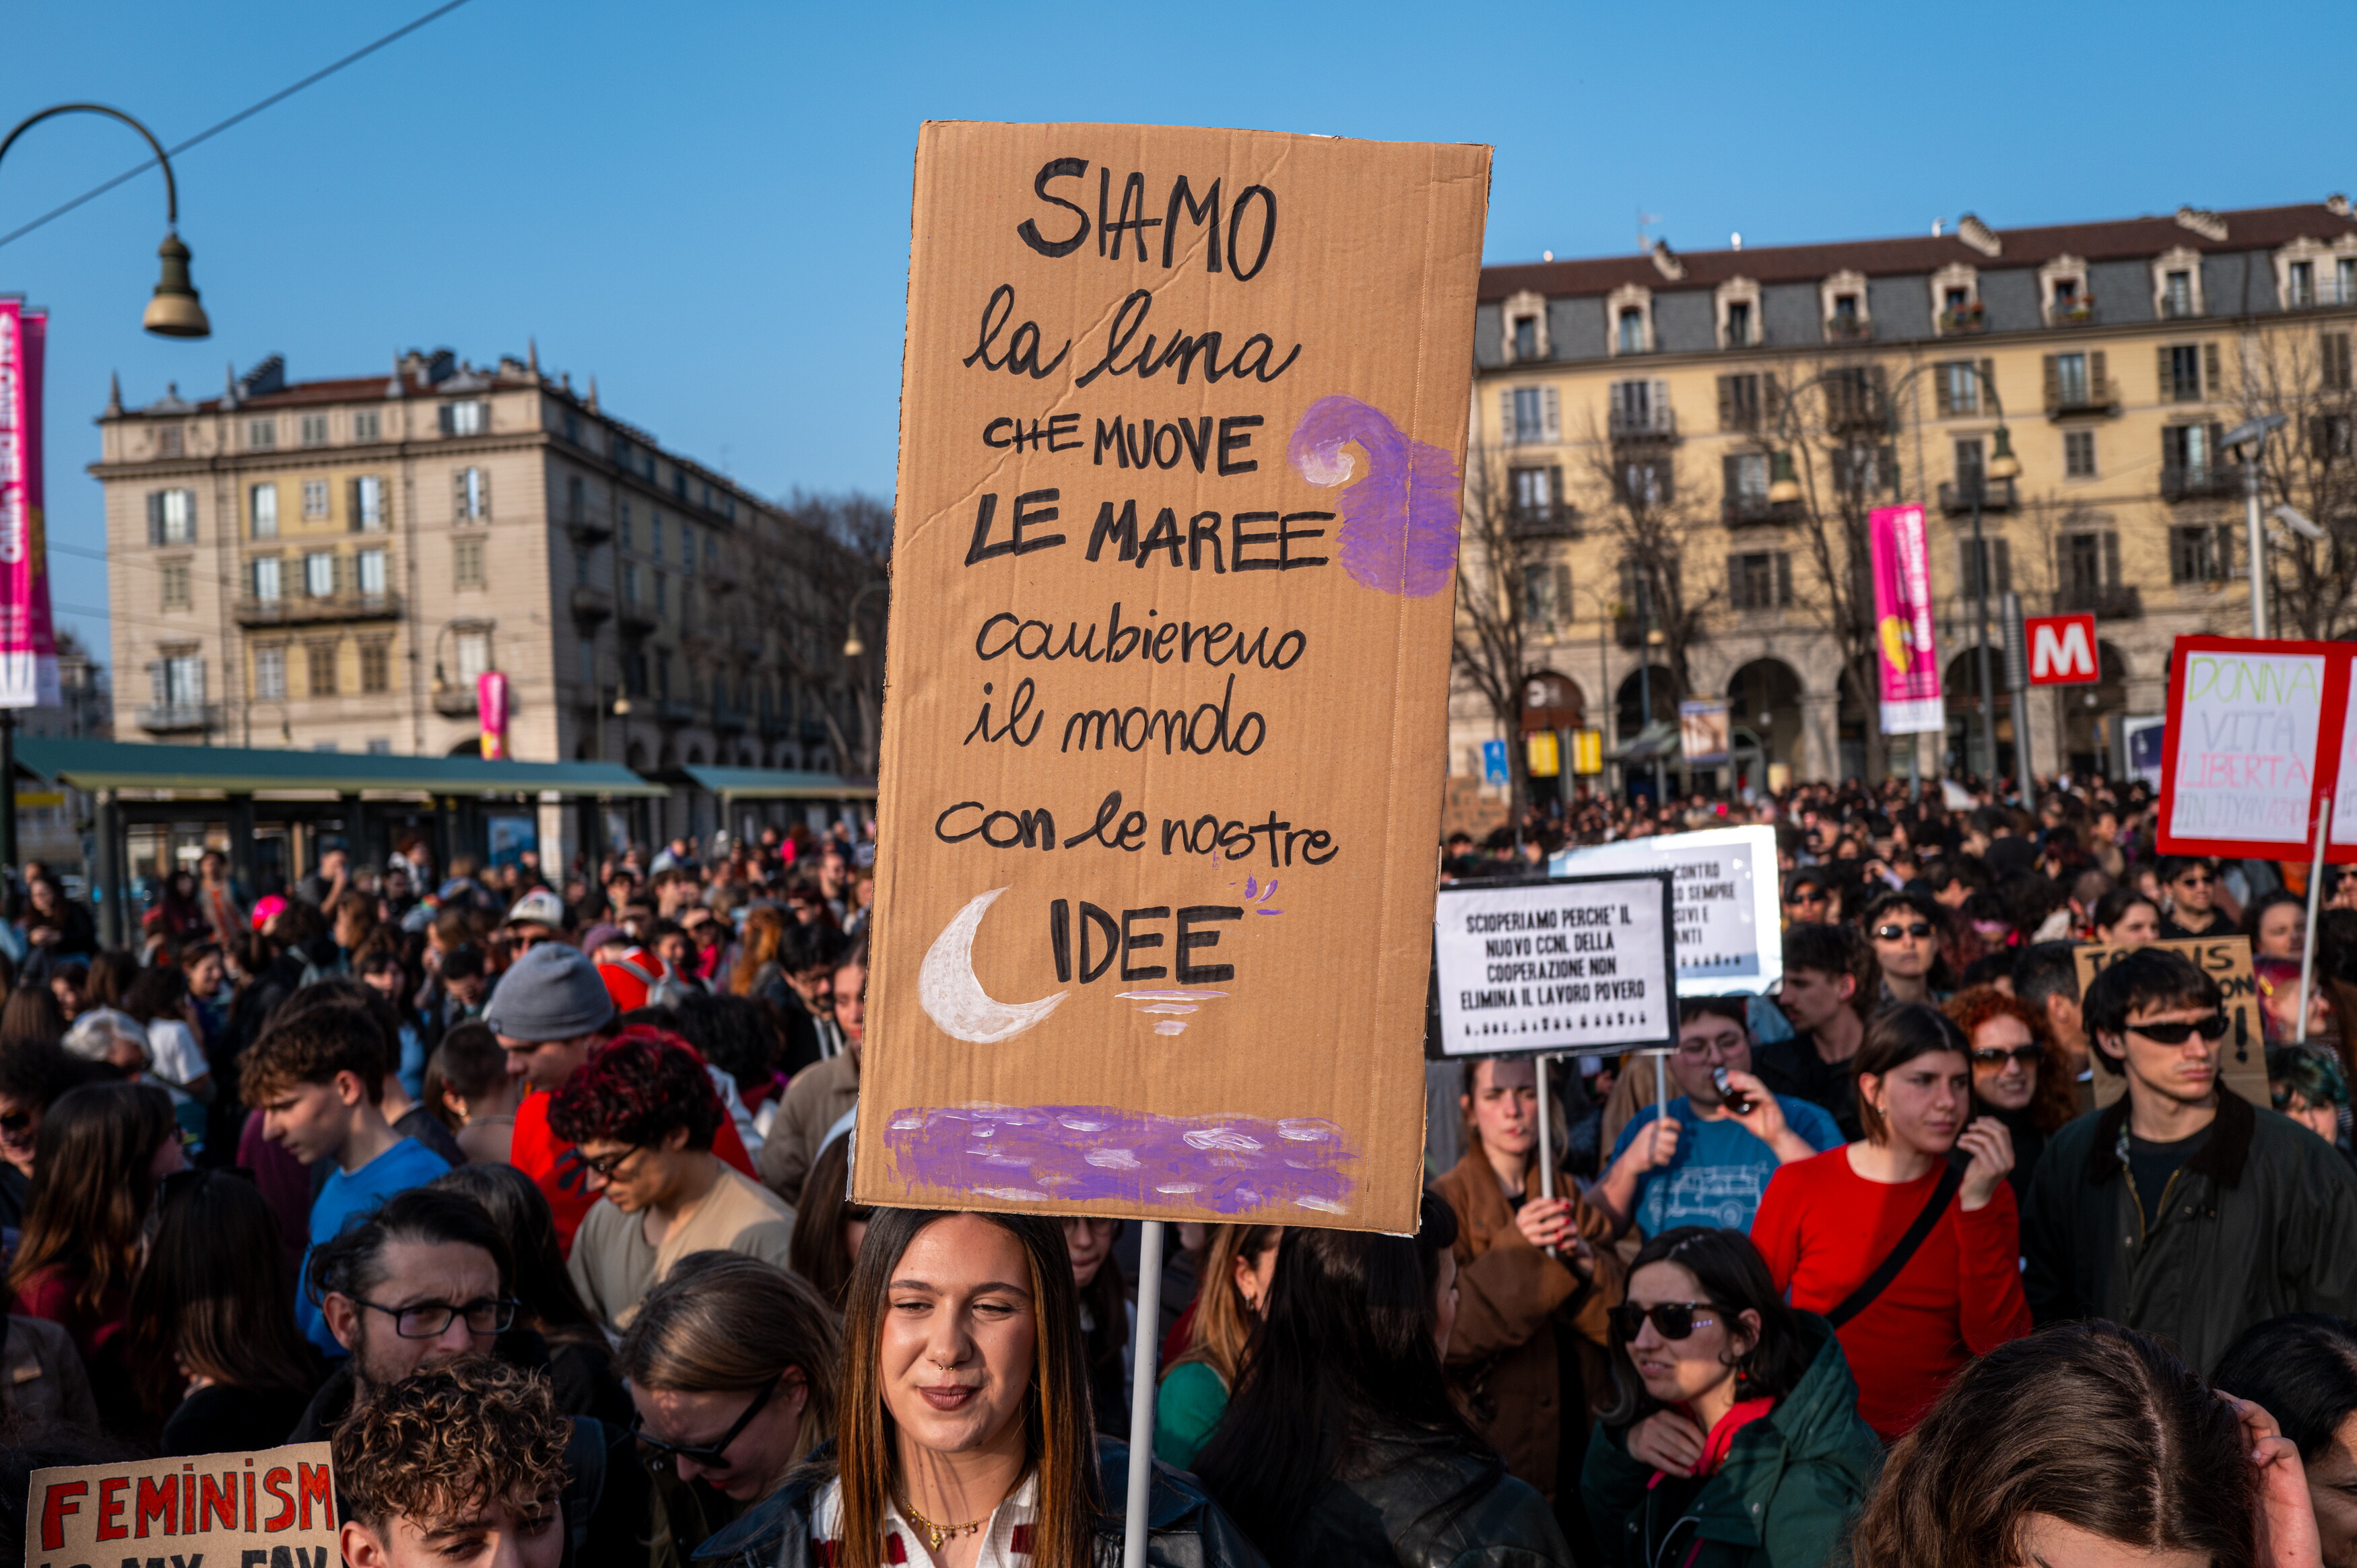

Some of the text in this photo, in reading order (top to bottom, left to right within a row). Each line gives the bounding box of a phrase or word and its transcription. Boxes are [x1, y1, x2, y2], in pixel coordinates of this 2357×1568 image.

[1017, 158, 1277, 281] SIAMO
[962, 284, 1302, 388] la luna
[983, 413, 1264, 477] CHE MUOVE
[964, 488, 1336, 574] LE MAREE
[2034, 623, 2094, 677] M
[2189, 658, 2318, 704] DONNA
[964, 673, 1265, 755] il mondo
[2201, 709, 2295, 753] VITA
[2178, 751, 2309, 790] LIBERTÀ
[935, 790, 1339, 867] con le nostre
[1688, 881, 1735, 900] SEMPRE
[1051, 899, 1244, 984] IDEE
[1466, 904, 1632, 934] SCIOPERIAMO PERCHE' IL
[1486, 931, 1614, 957] NUOVO CCNL DELLA
[1487, 955, 1616, 984] COOPERAZIONE NON
[1461, 979, 1645, 1011] ELIMINA IL LAVORO POVERO
